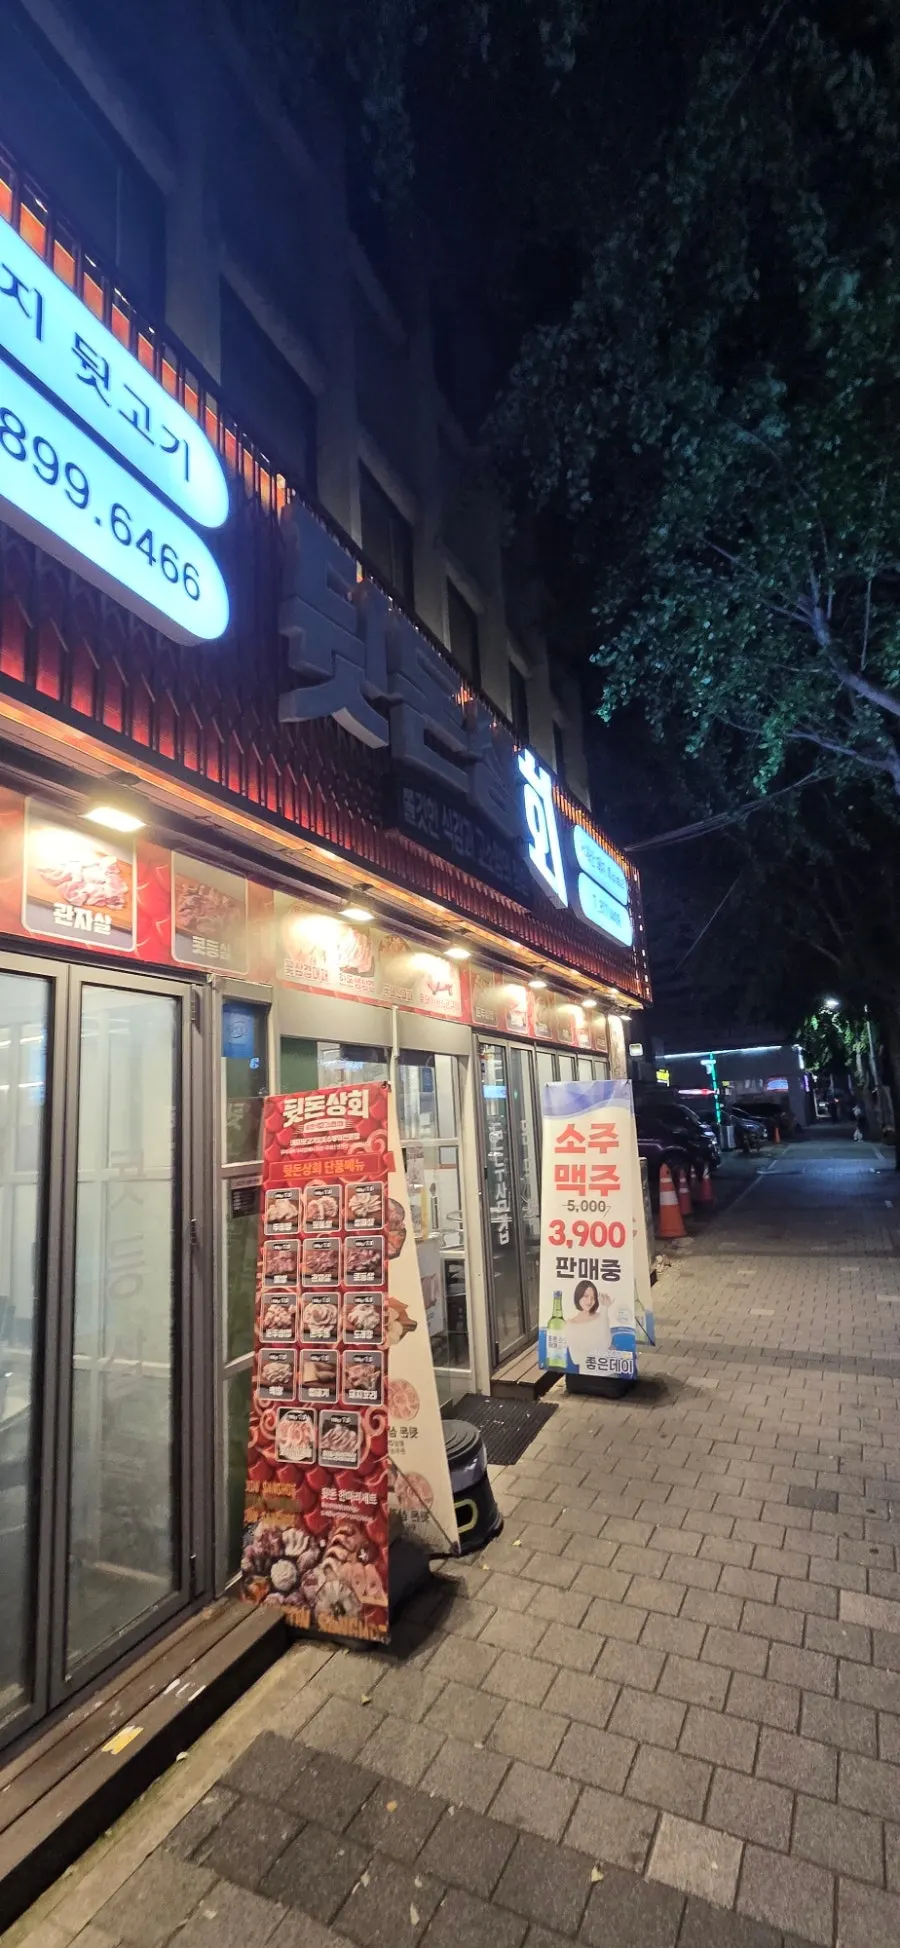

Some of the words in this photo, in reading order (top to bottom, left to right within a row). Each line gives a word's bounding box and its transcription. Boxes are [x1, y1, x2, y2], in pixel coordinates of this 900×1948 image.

[71, 332, 192, 483] 뒷고기
[0, 407, 201, 602] 899.6466
[53, 902, 112, 935] 관자살
[283, 1089, 369, 1128] 뒷돈상회
[554, 1123, 620, 1154] 소주
[283, 1161, 322, 1178] 뒷돈상회
[554, 1164, 620, 1196] 맥주
[567, 1199, 607, 1213] 5,000
[548, 1219, 626, 1249] 3,900
[555, 1256, 622, 1282] 판매중
[585, 1356, 634, 1374] 좋은데이
